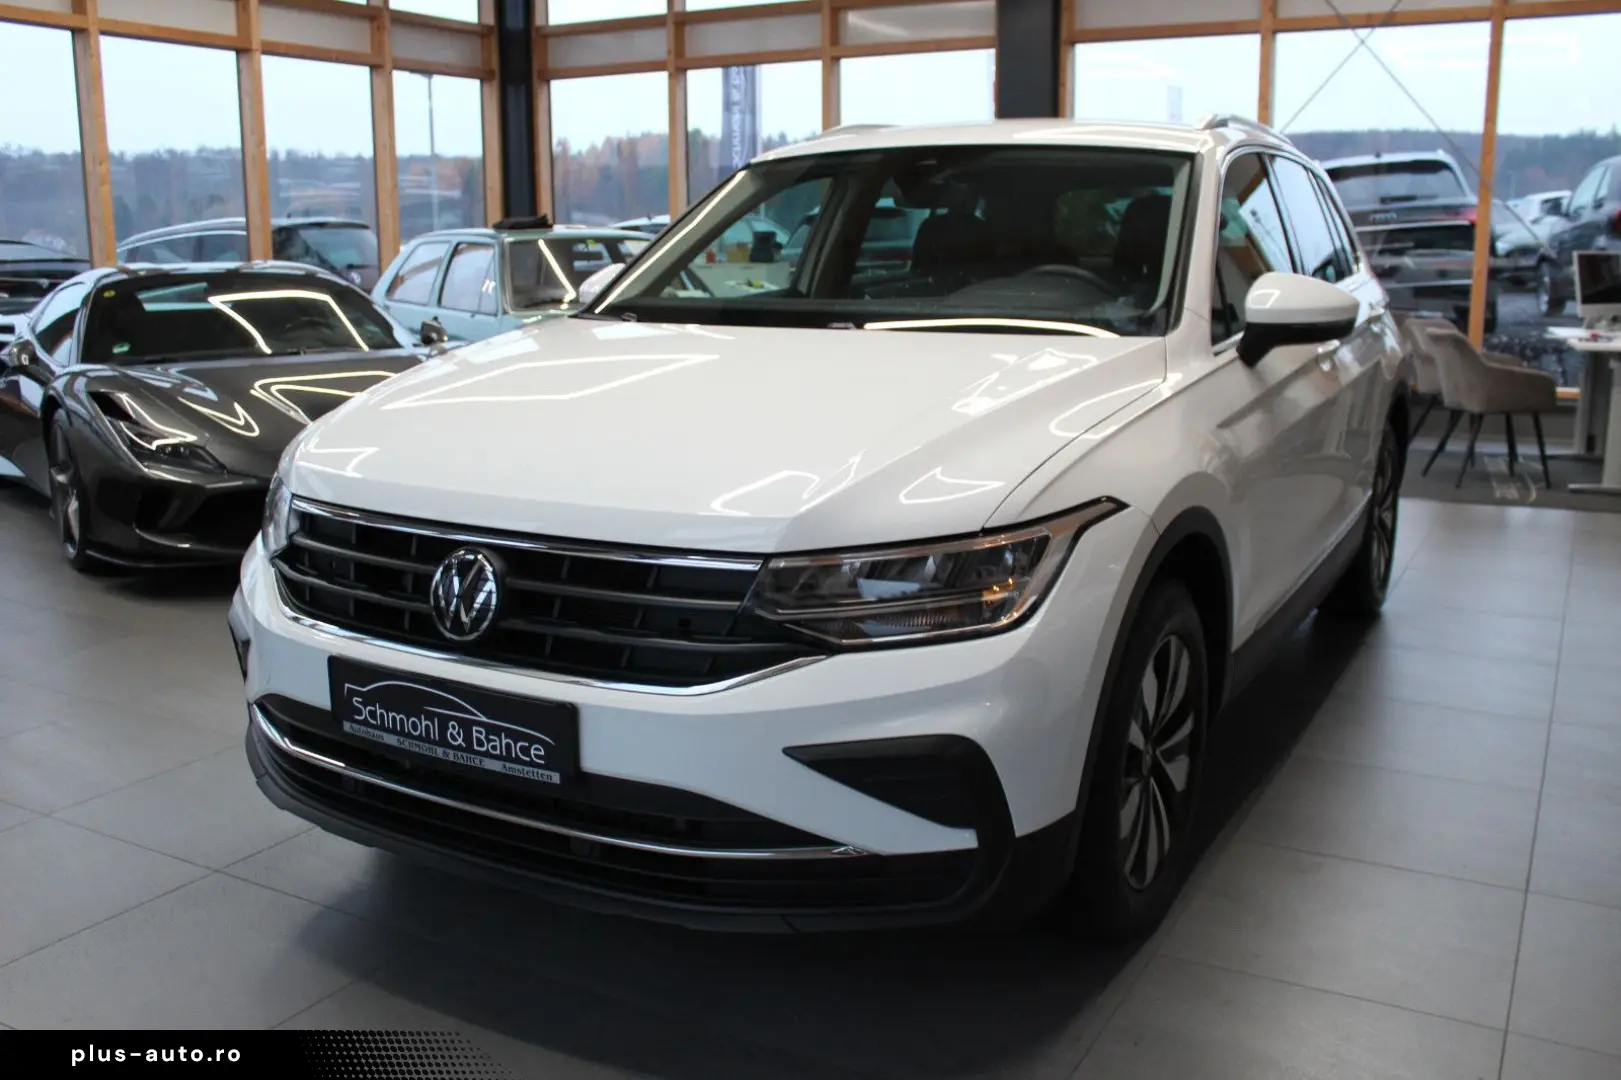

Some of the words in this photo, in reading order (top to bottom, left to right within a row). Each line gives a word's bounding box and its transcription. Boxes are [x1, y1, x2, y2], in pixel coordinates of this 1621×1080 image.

[352, 696, 439, 741] Schmohl
[447, 720, 466, 748] &
[472, 726, 545, 764] Bahce
[397, 738, 440, 757] SCHMOHL
[442, 750, 452, 759] &
[453, 752, 485, 766] BAHCE
[501, 763, 553, 781] Amstetten
